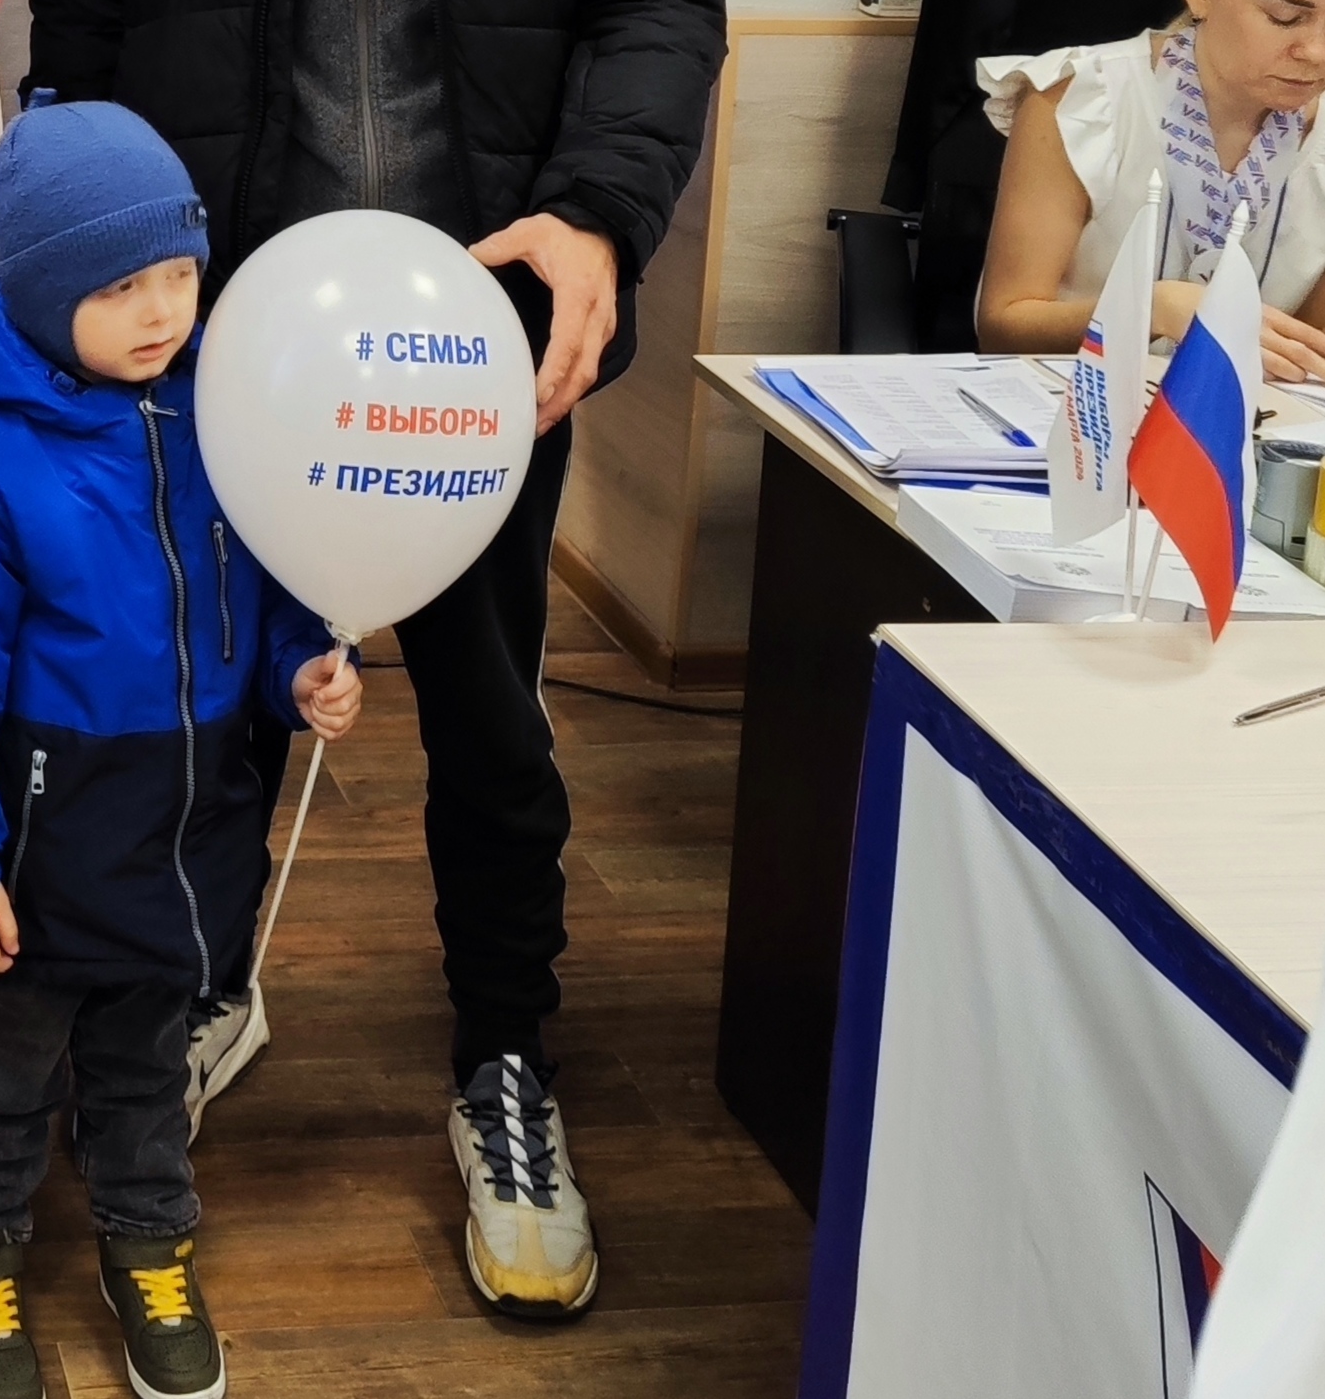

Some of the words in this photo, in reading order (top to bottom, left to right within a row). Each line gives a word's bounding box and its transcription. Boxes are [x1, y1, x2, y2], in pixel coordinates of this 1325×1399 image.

[386, 332, 488, 365] СЕМЬЯ
[366, 403, 498, 436] ВЫБОРЫ
[1075, 359, 1091, 439] РОССИИ
[1084, 363, 1103, 492] ПРЕЗИДЕНТА
[1096, 368, 1112, 460] ВЫБОРЫ
[336, 464, 510, 502] ПРЕЗИДЕНТ
